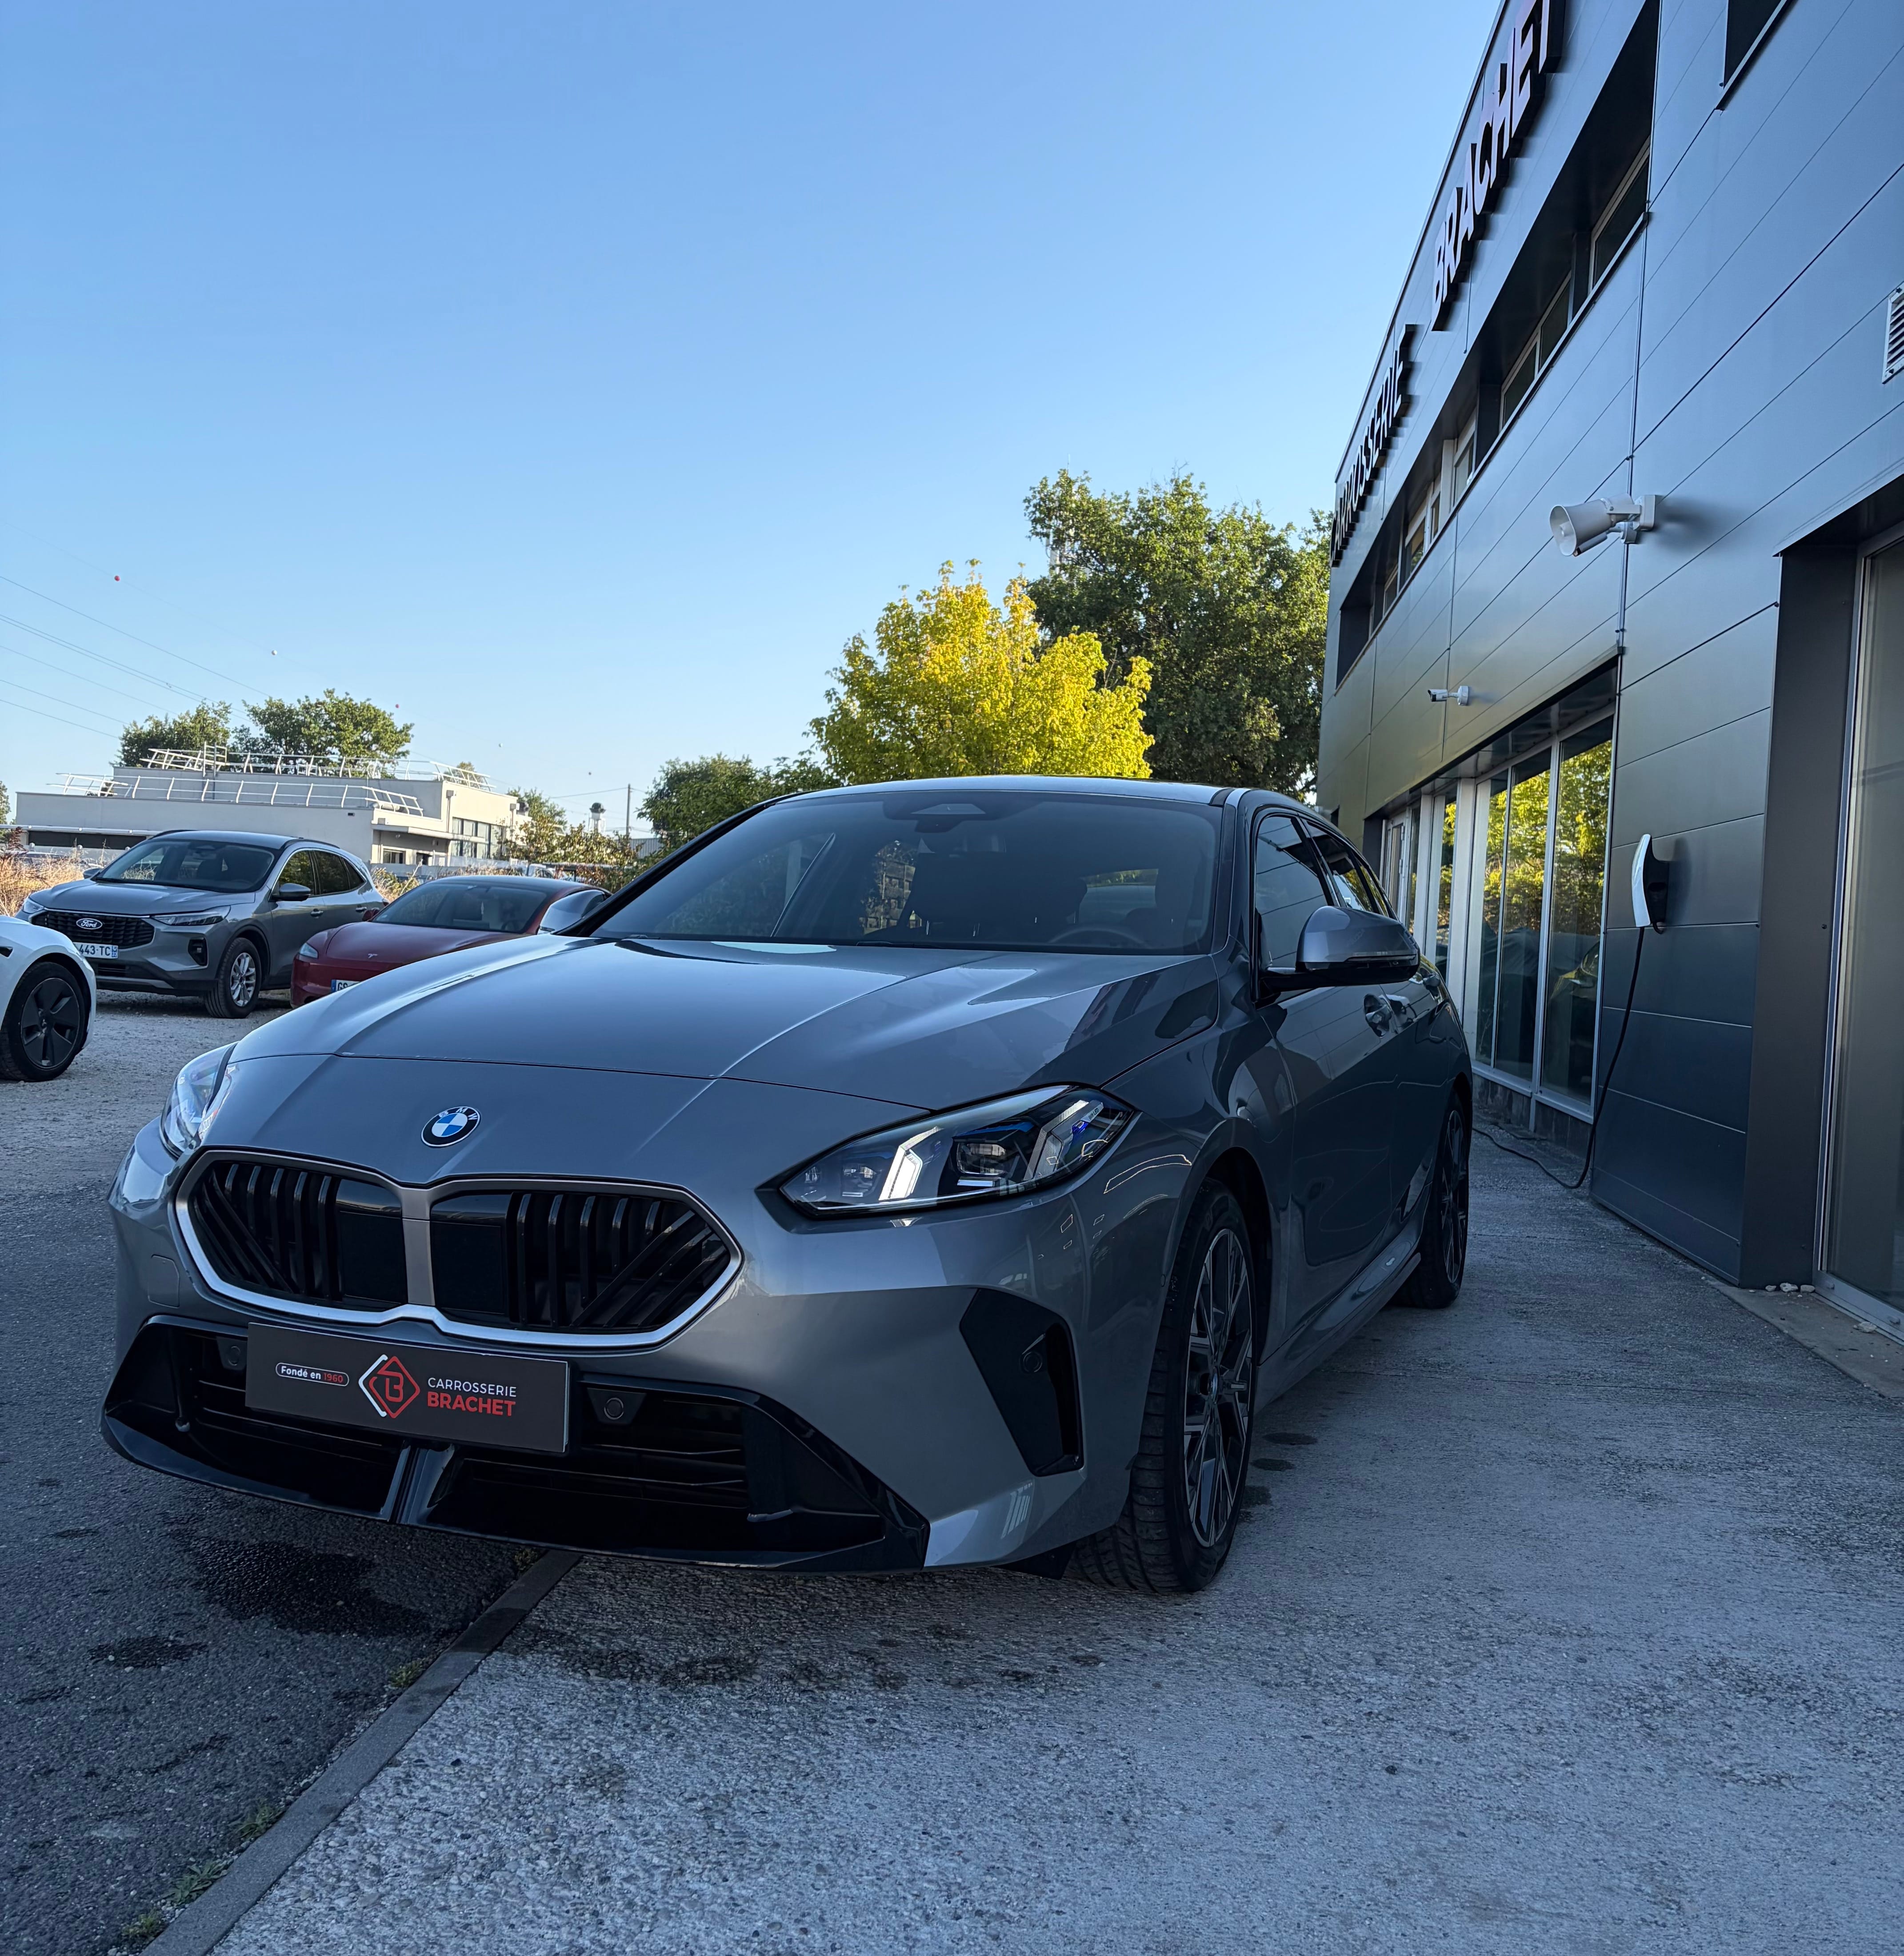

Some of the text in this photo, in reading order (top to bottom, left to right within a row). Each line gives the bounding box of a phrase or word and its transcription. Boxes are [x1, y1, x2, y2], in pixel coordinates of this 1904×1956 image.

[1330, 324, 1406, 568] CARROSSERIE
[81, 919, 97, 927] Ford
[438, 1107, 478, 1120] BMW
[281, 1366, 308, 1377] Fondé
[324, 1372, 344, 1383] 1960
[428, 1377, 517, 1397] CARROSSERIE
[427, 1391, 516, 1416] BRACHET
